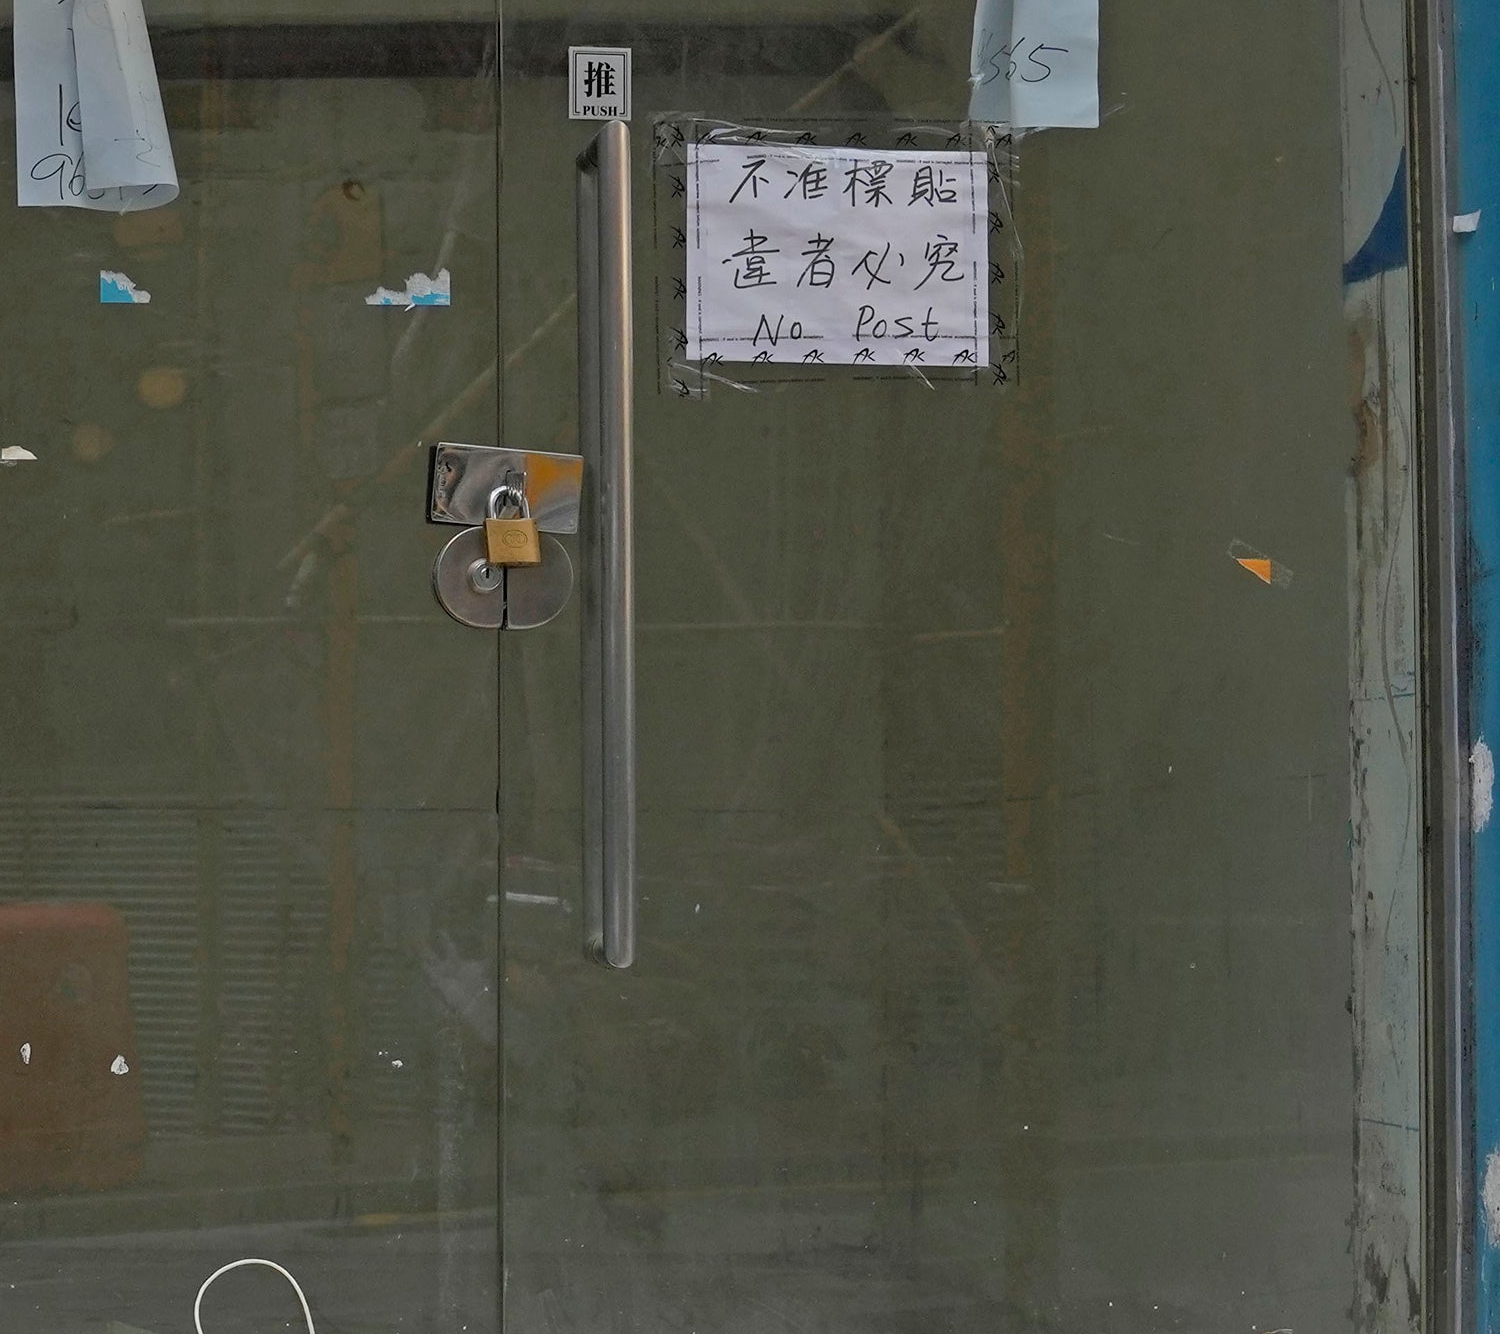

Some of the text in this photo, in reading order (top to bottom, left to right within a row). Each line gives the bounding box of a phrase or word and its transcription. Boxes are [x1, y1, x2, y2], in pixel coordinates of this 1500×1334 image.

[583, 60, 617, 99] 推
[581, 105, 618, 118] PUSH
[721, 228, 965, 291] 違者必究
[752, 304, 940, 347] No Post
